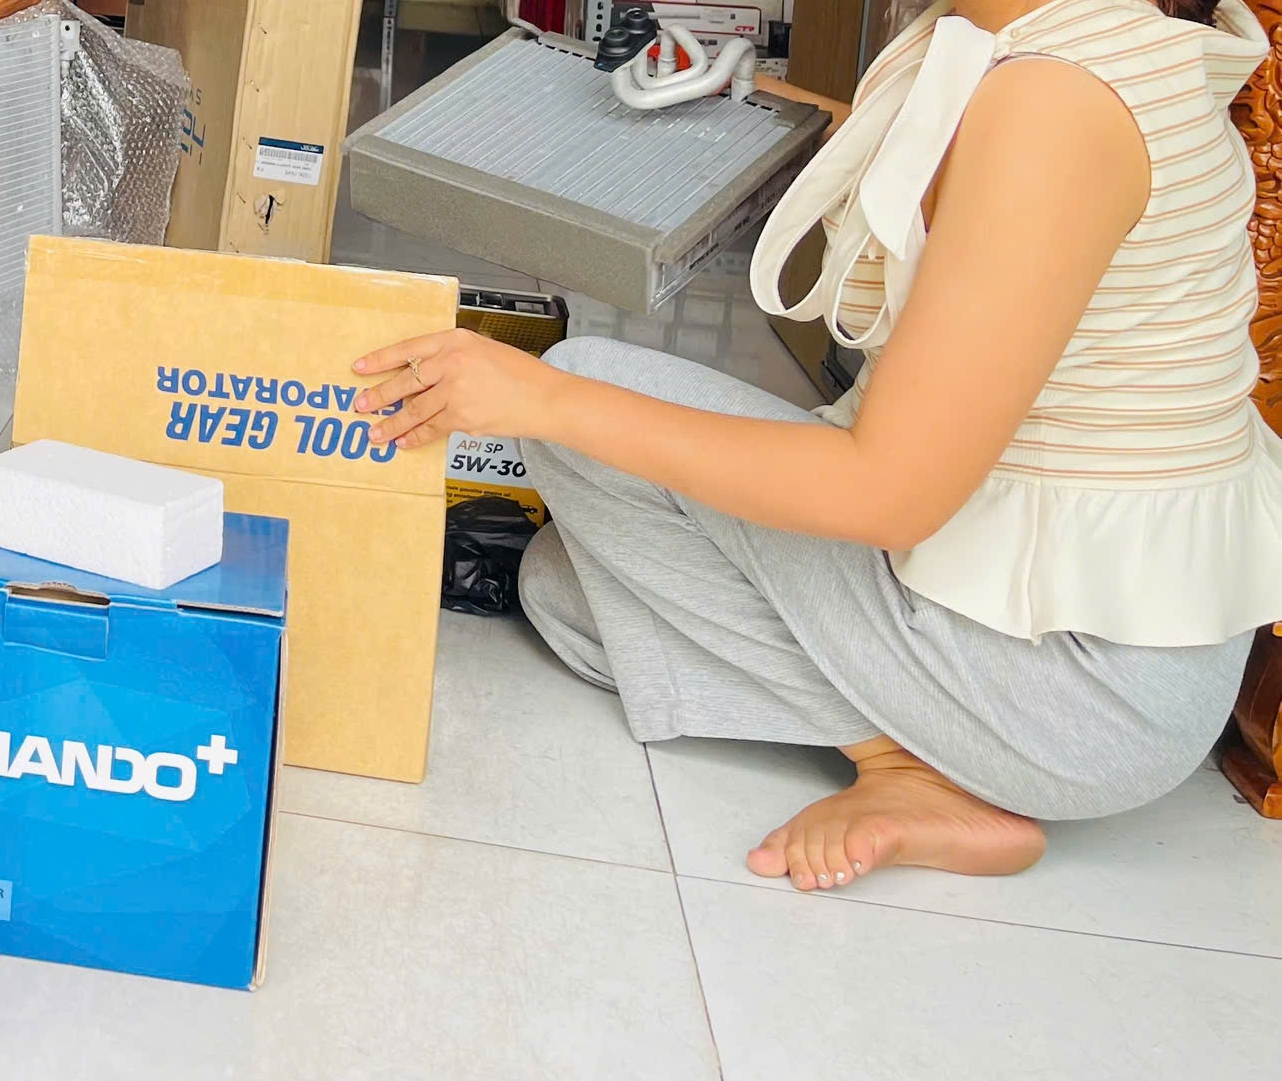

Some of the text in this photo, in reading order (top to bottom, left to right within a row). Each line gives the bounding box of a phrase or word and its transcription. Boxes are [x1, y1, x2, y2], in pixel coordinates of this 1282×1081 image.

[165, 401, 279, 450] GEAR
[456, 439, 504, 454] API SP
[450, 454, 527, 478] 5W-30
